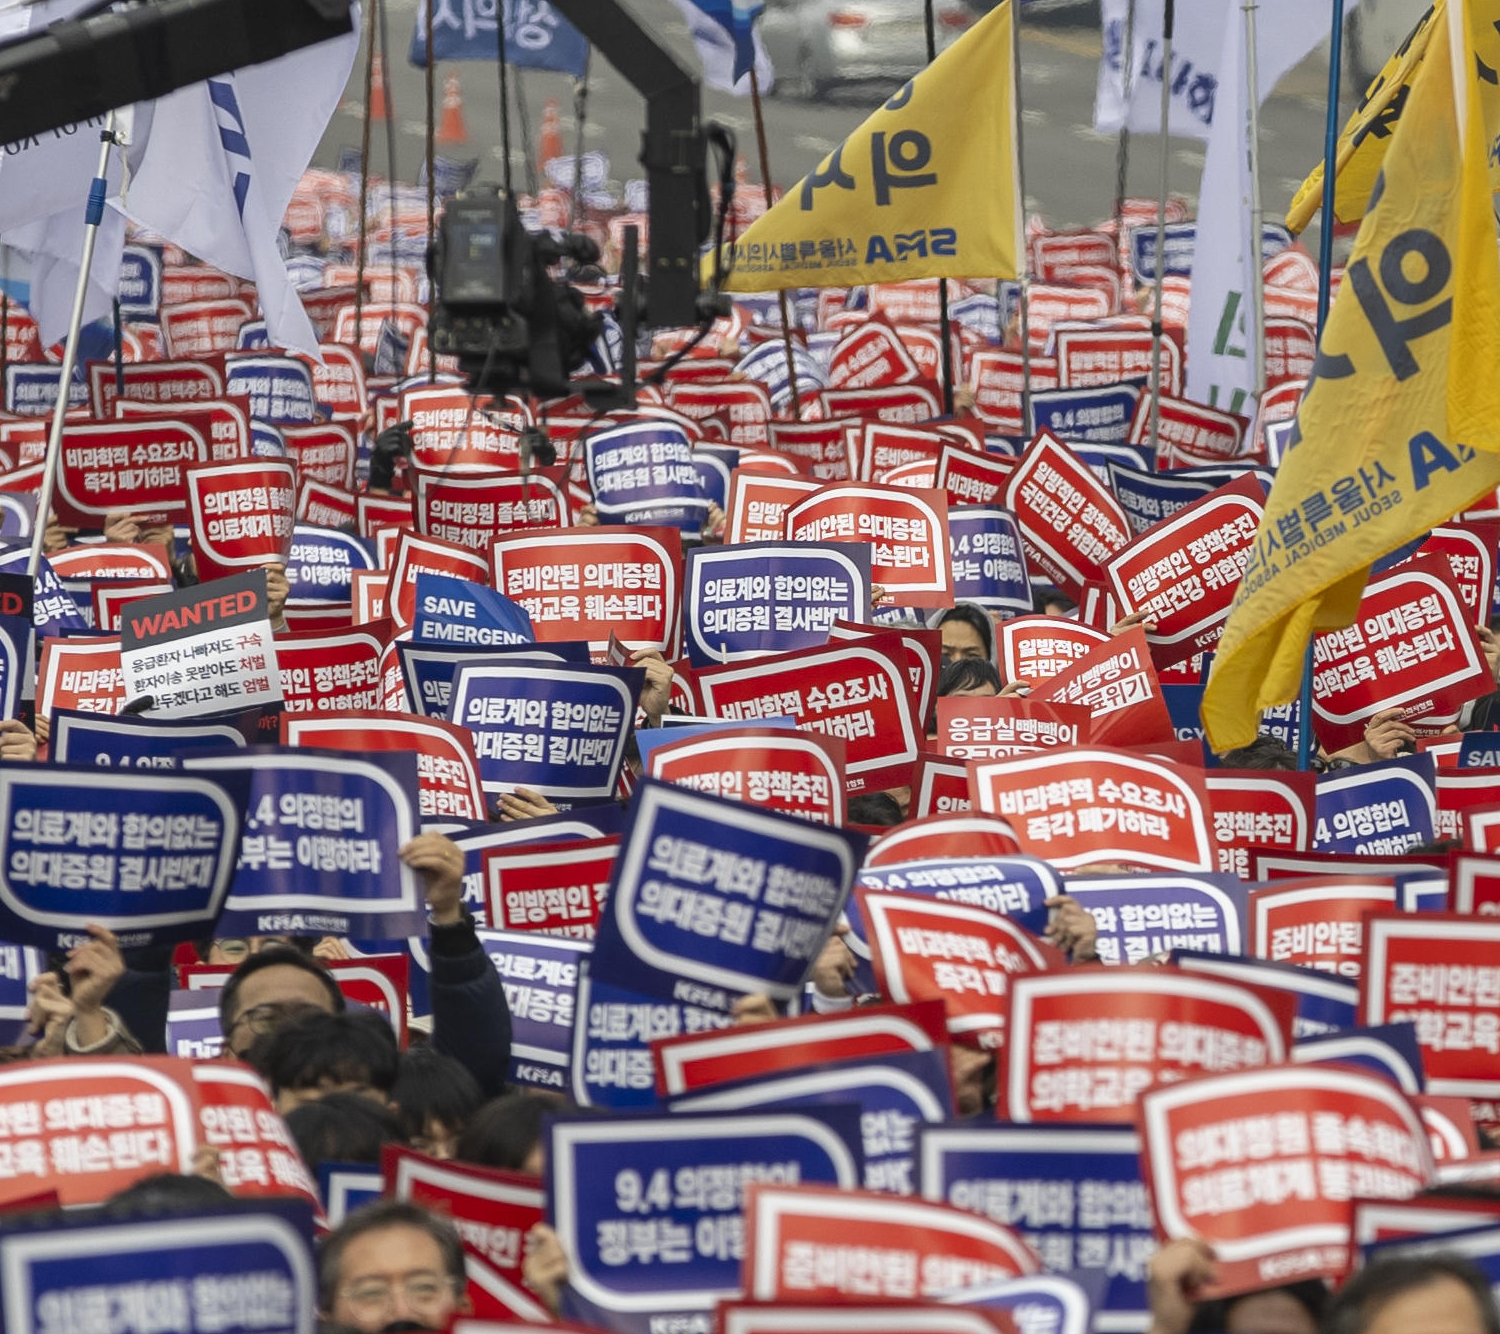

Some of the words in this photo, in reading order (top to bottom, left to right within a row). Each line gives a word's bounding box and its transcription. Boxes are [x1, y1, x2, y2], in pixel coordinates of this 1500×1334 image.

[67, 444, 128, 469] 비과학적
[132, 442, 195, 465] 수요조사
[83, 469, 115, 491] 즉각
[118, 467, 181, 490] 폐기하라
[1034, 462, 1085, 512] 일방적인
[430, 500, 494, 523] 의대정원
[497, 500, 556, 522] 졸속확대
[507, 566, 581, 594] 준비안된
[583, 563, 661, 589] 의대증원
[1127, 558, 1189, 601] 일방적인
[1188, 513, 1256, 556] 정책추진
[130, 589, 258, 639] WANTED
[424, 596, 476, 618] SAVE
[131, 646, 179, 674] 응급환자
[183, 639, 234, 664] 나빠져도
[235, 631, 262, 652] 구속
[134, 669, 183, 695] 환자이송
[187, 660, 238, 684] 못받아도
[239, 652, 266, 672] 처벌
[1313, 652, 1372, 701] 의학교육
[1375, 624, 1451, 676] 훼손된다
[214, 680, 241, 701] 해도
[243, 674, 271, 695] 엄벌
[720, 690, 803, 728] 비과학적
[805, 672, 889, 713] 수요조사
[468, 697, 548, 725] 의료계와
[550, 703, 620, 731] 합의없는
[951, 716, 1080, 751] 응급실뺑뺑이
[999, 780, 1094, 822] 비과학적
[1098, 779, 1188, 822] 수요조사
[298, 837, 383, 876] 이행하라
[258, 915, 305, 933] KMA
[638, 883, 747, 944] 의대증원
[42, 1094, 167, 1136] 의대증원
[50, 1131, 172, 1174] 훼손된다
[1177, 1117, 1309, 1167] 의대정원
[1313, 1112, 1420, 1165] 졸속확대
[1181, 1167, 1314, 1218] 의료체계
[595, 1220, 691, 1265] 정부는
[198, 1278, 297, 1328] 합의없는
